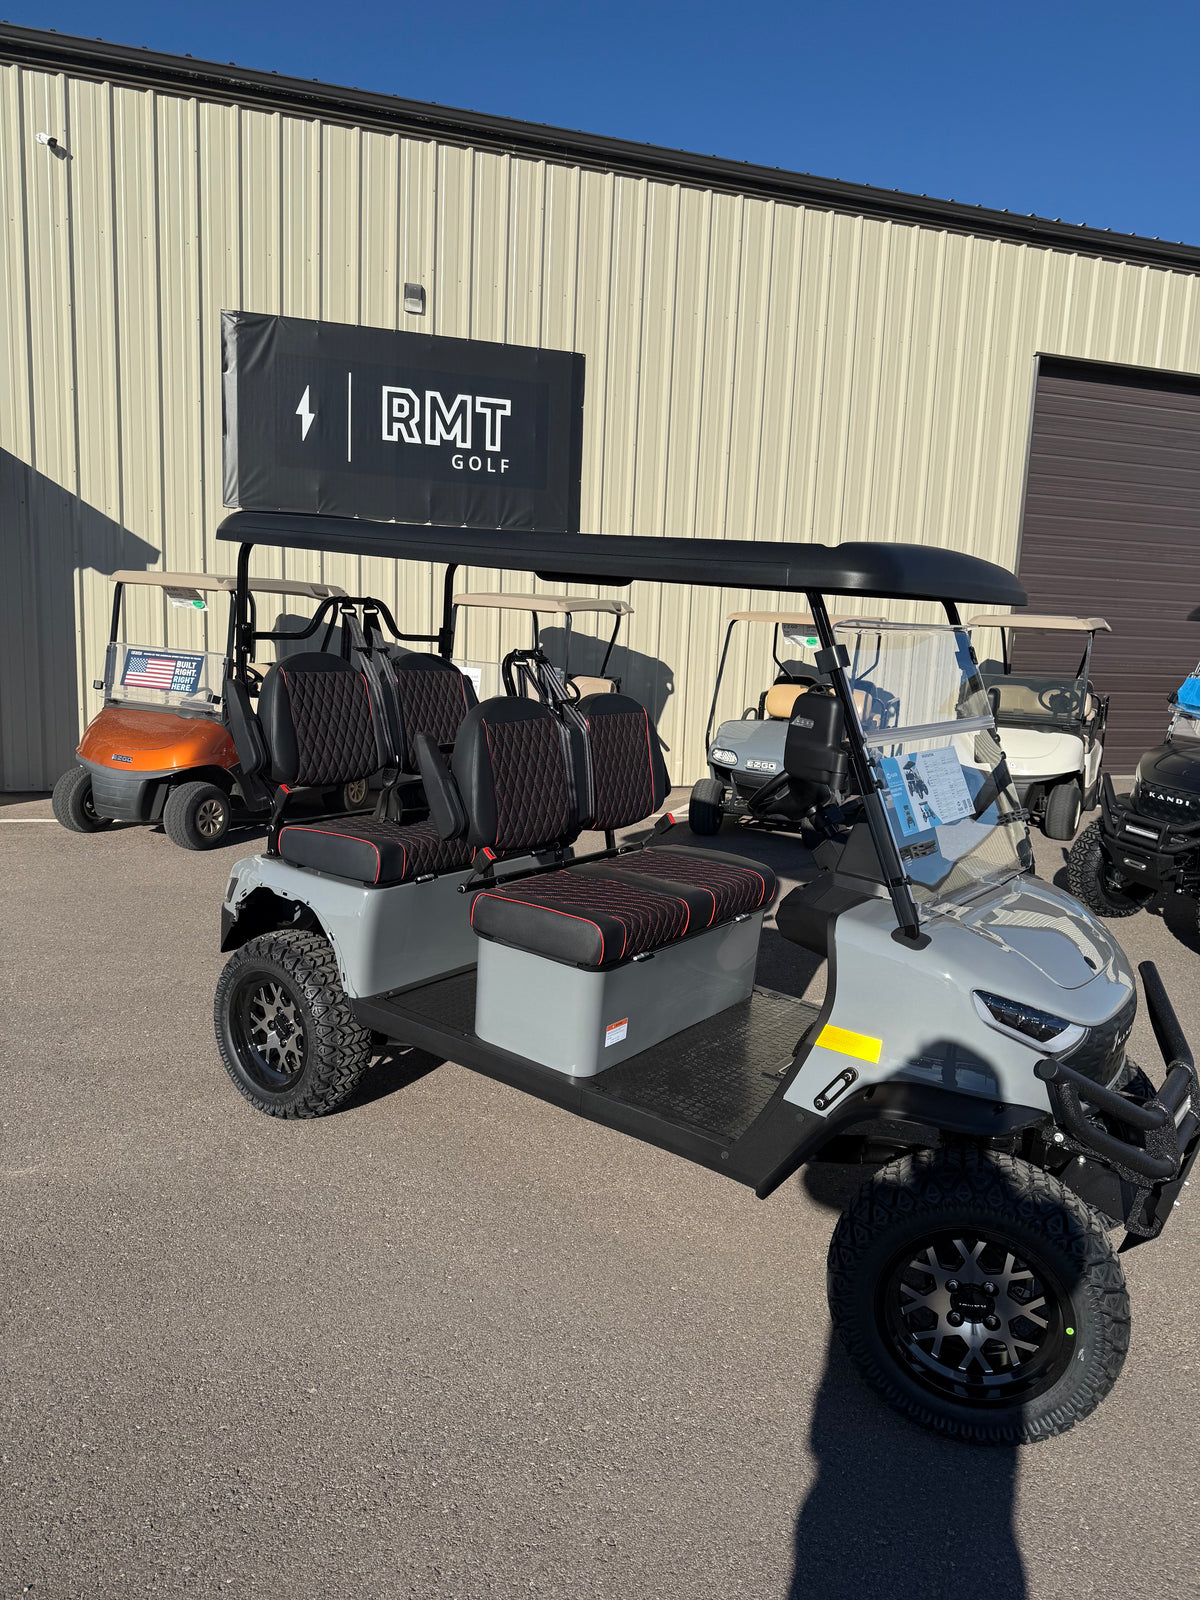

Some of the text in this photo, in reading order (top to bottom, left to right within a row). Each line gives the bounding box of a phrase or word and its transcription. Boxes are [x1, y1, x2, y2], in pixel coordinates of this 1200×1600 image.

[381, 385, 511, 452] RMT
[451, 454, 509, 474] GOLF
[176, 660, 197, 669] BUILT
[172, 675, 195, 685] RIGHT
[171, 683, 192, 692] HERE.
[1149, 791, 1190, 807] KANDI
